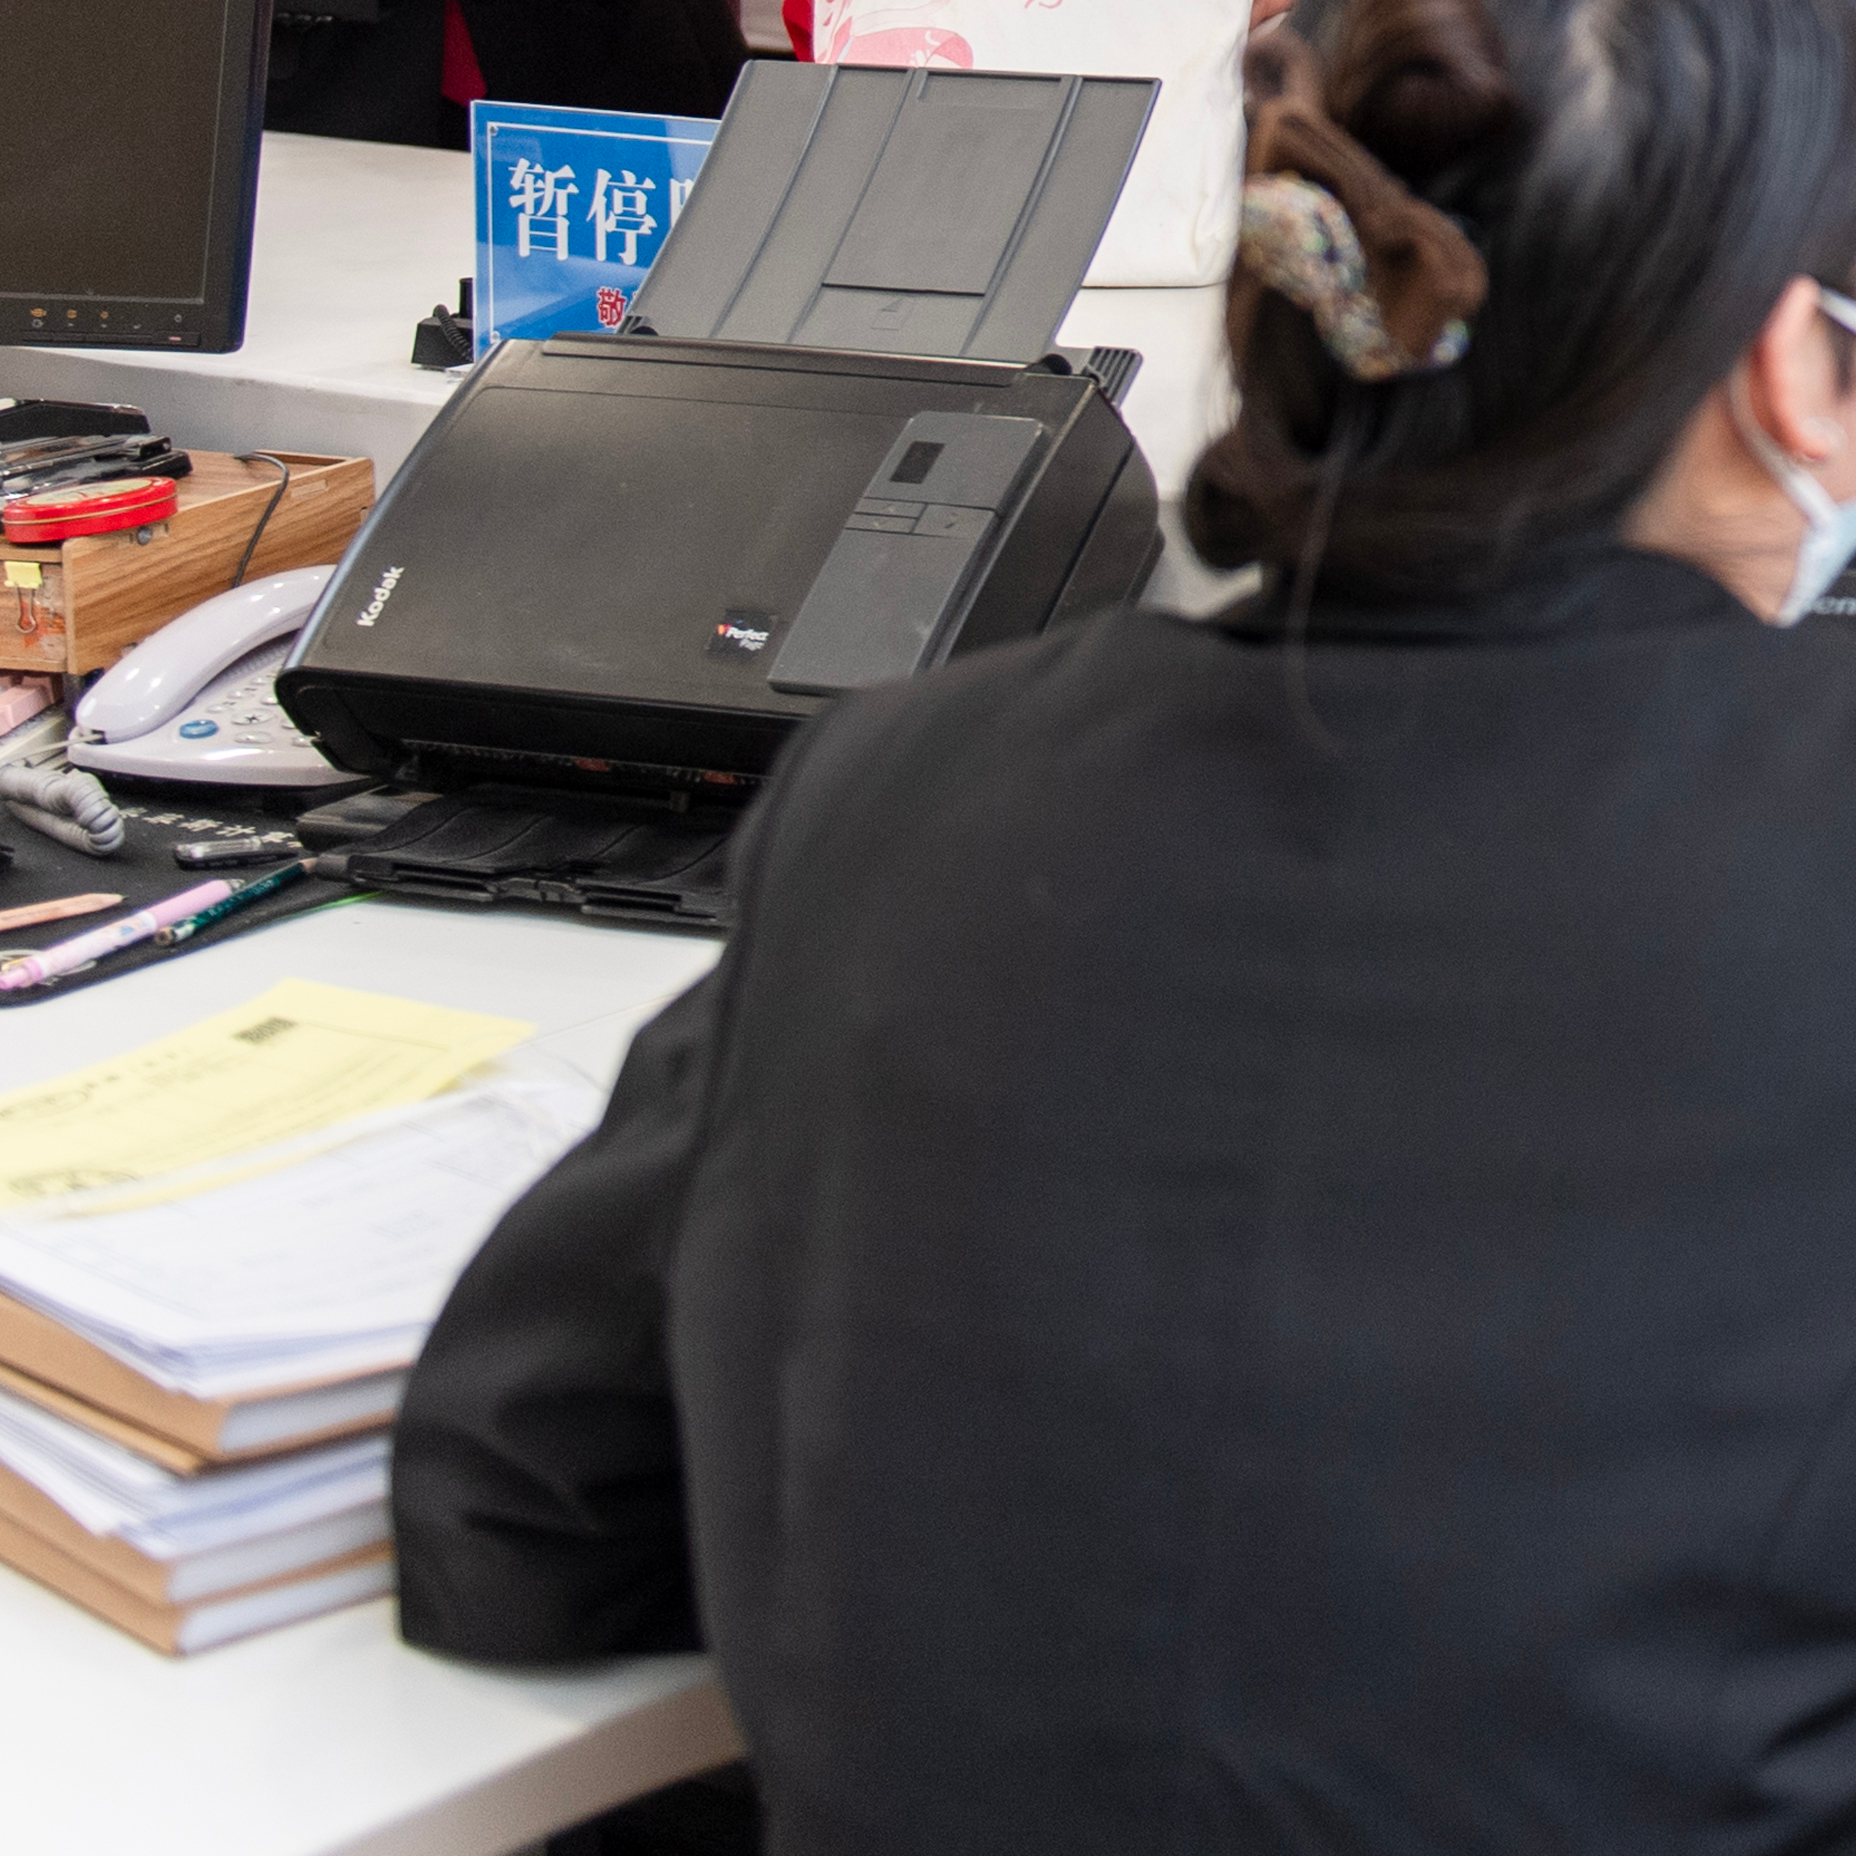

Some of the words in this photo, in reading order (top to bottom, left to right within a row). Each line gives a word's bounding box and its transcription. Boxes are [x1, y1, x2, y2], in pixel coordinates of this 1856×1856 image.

[508, 157, 695, 266] 暂停
[356, 566, 405, 627] Kodak
[726, 627, 769, 641] Perfect
